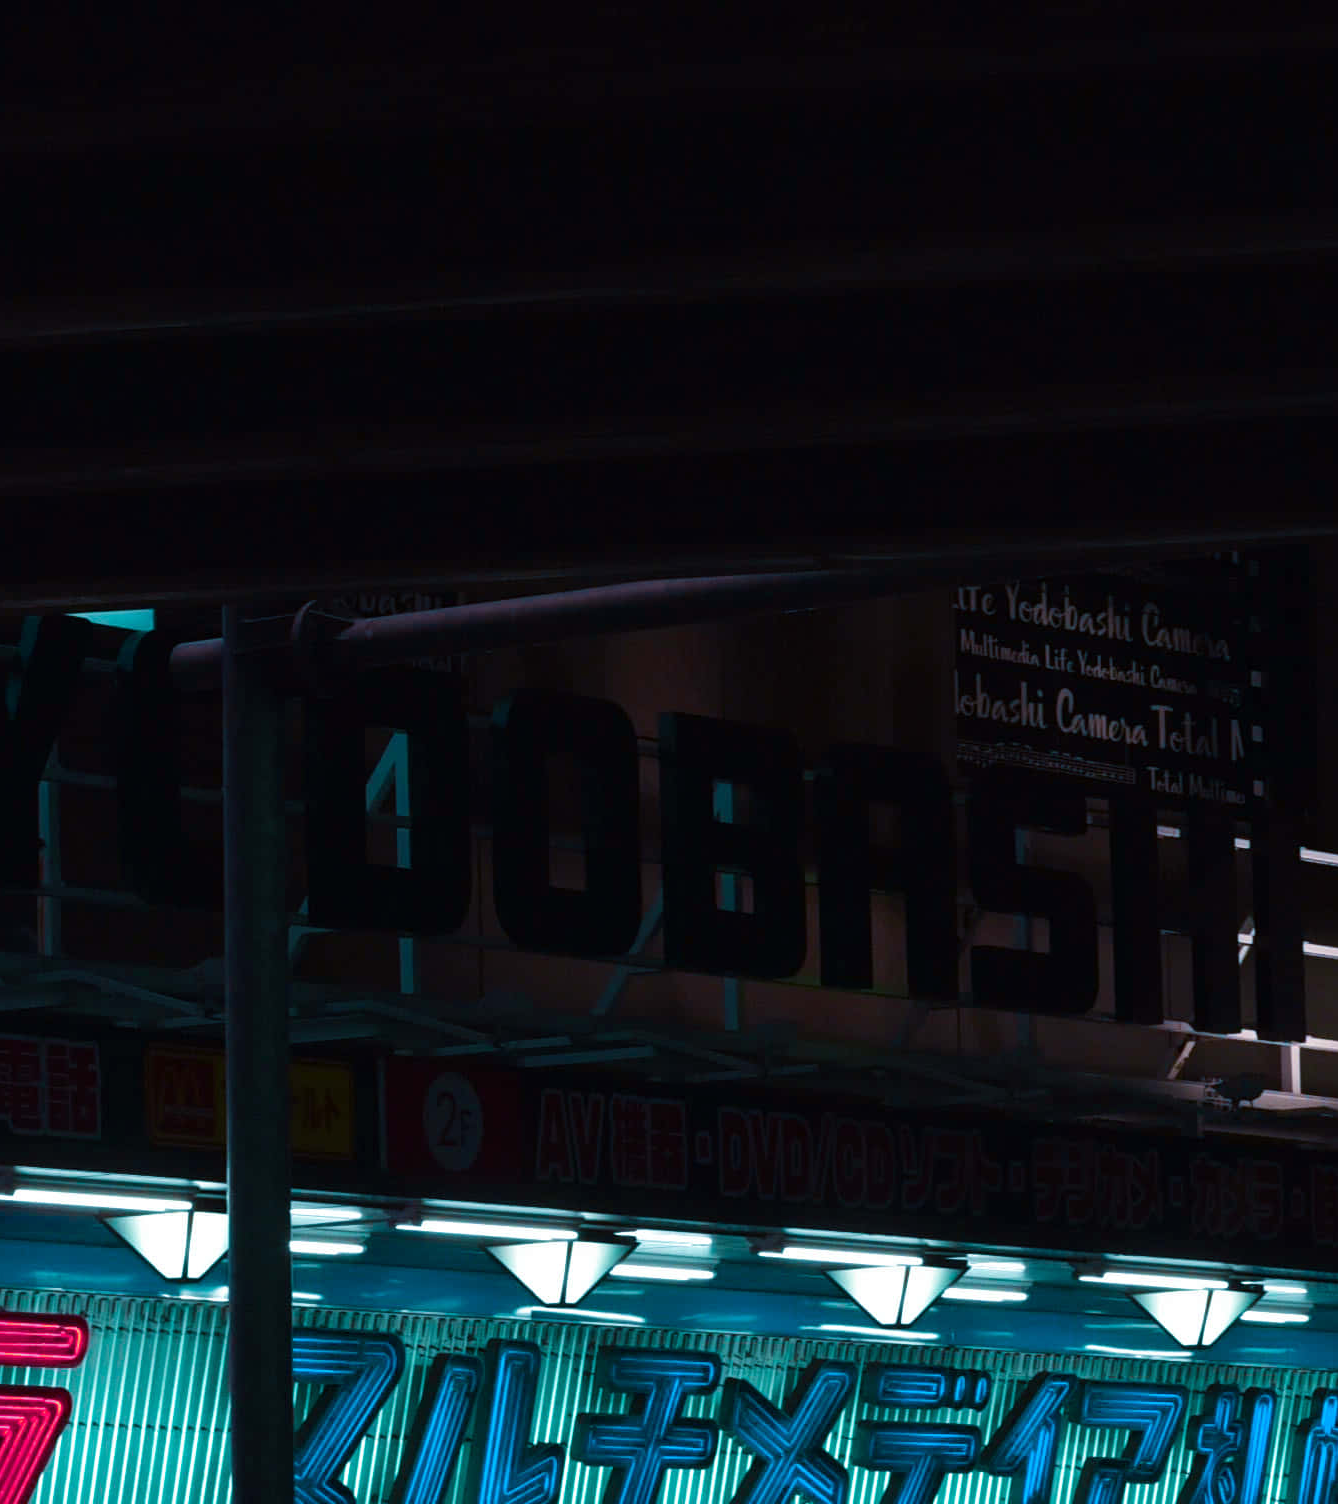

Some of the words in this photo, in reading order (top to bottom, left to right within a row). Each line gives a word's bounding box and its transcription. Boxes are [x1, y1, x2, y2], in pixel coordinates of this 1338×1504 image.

[1004, 579, 1134, 643] Yodobashi
[1140, 601, 1232, 664] Camera
[1044, 643, 1076, 675] Life
[1075, 648, 1147, 689] Yodobashi
[1055, 687, 1150, 748] Camera
[1149, 703, 1222, 761] Total
